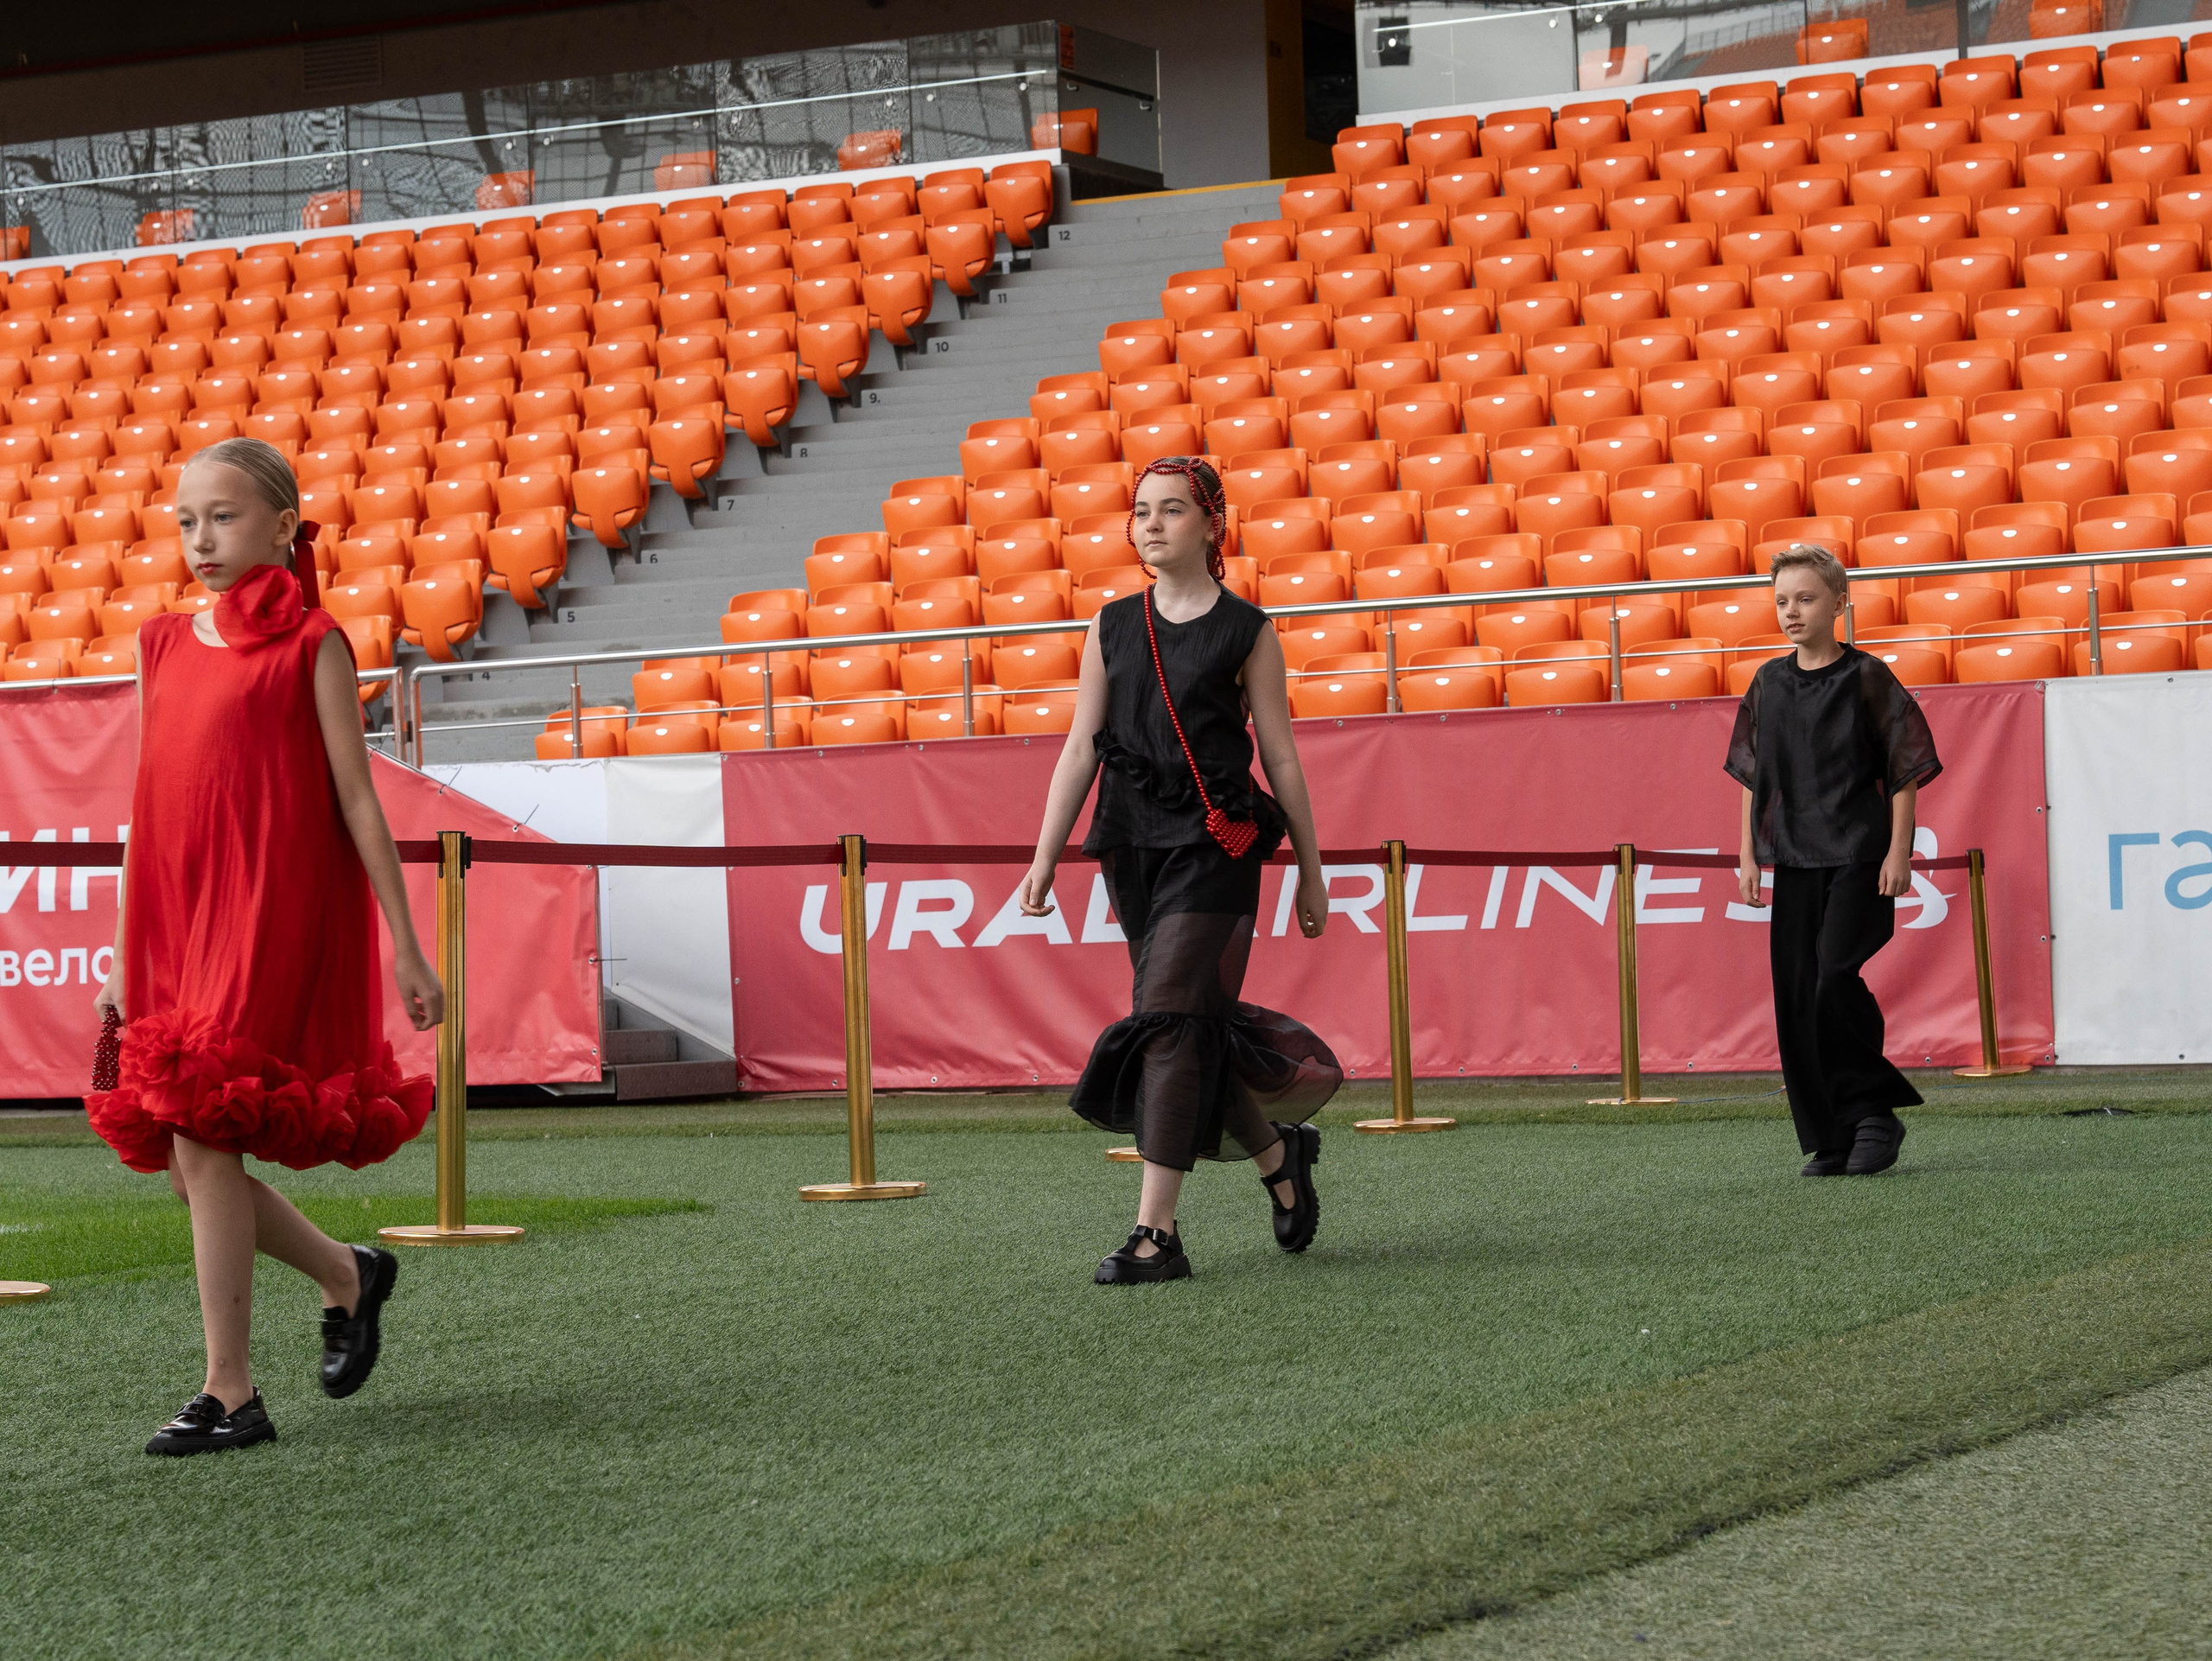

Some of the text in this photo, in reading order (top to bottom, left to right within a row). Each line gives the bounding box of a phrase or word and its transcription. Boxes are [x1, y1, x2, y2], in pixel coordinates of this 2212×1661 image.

[1058, 231, 1071, 240] 12
[997, 293, 1007, 303] 11
[936, 341, 949, 353] 10
[800, 448, 809, 458] 8
[727, 500, 735, 511] 7
[650, 553, 658, 563] 6
[567, 611, 575, 622] 5
[482, 671, 490, 680] 4
[799, 873, 1129, 954] URAL
